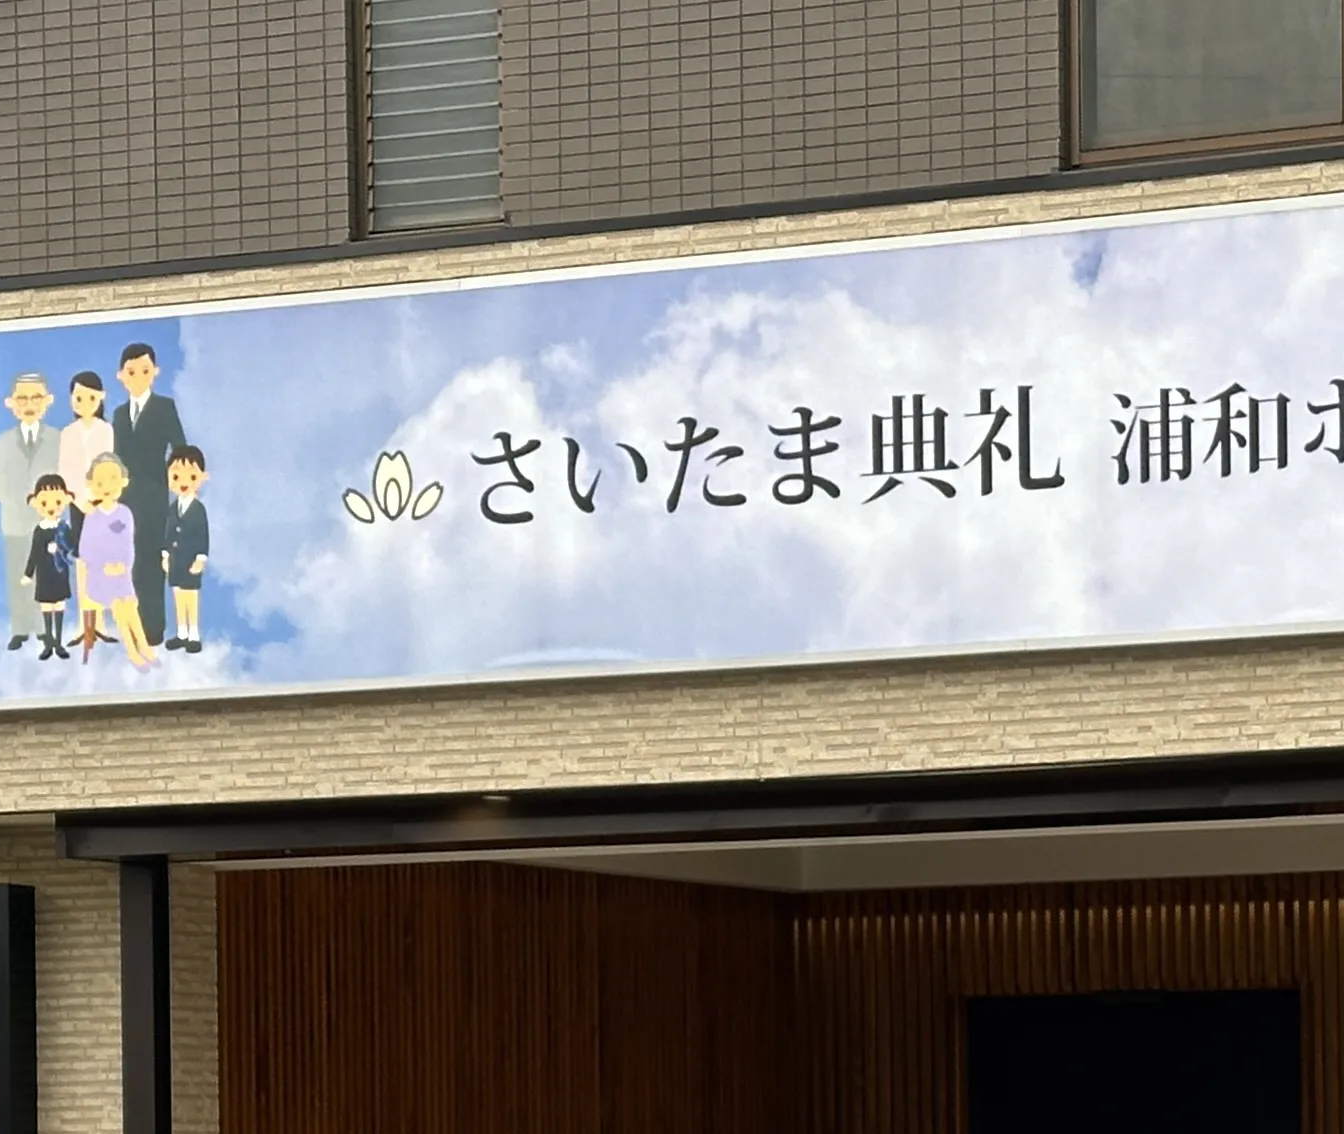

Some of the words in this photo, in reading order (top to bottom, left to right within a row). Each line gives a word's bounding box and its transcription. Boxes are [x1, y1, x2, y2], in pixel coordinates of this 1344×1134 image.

[470, 384, 1066, 525] さいたま典礼
